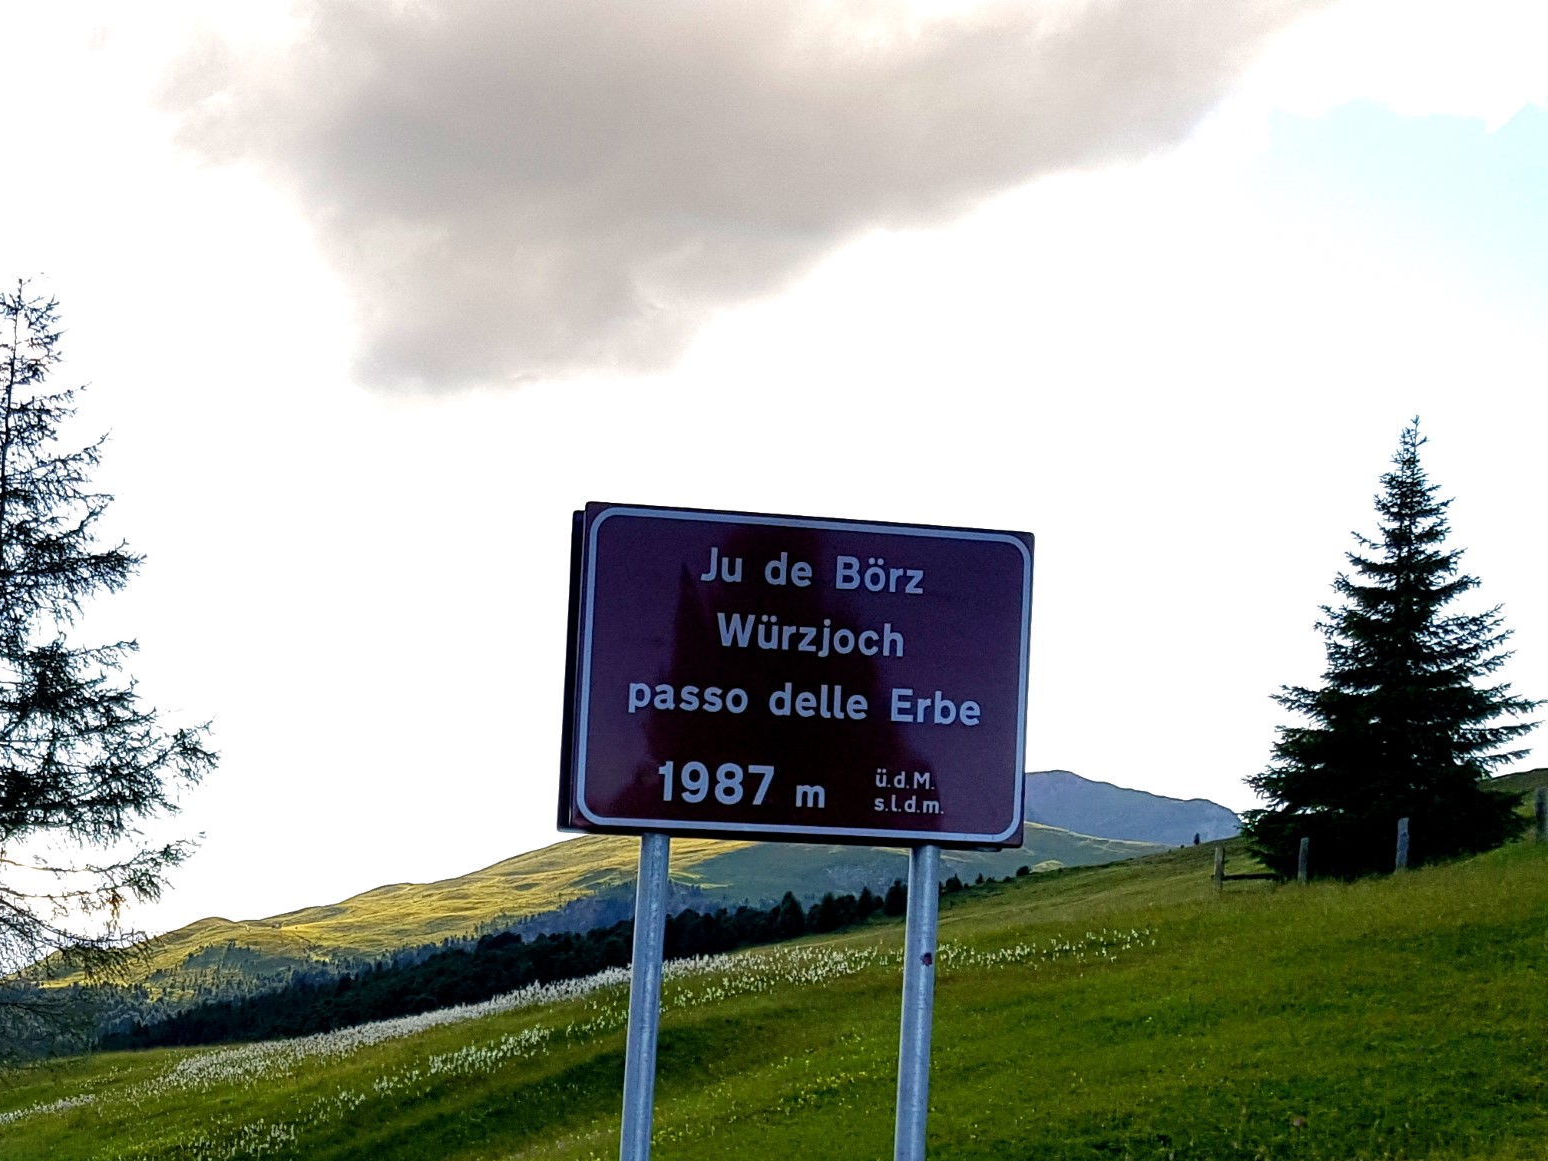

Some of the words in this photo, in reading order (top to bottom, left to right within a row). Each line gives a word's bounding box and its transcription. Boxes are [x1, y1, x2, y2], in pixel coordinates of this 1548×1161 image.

[700, 547, 743, 584] Ju
[765, 551, 812, 588] de
[835, 555, 924, 594] Börz
[717, 612, 904, 657] Würzjoch
[628, 682, 748, 715] passo
[769, 683, 868, 720] delle
[890, 688, 981, 726] Erbe
[657, 760, 775, 805] 1987
[795, 784, 825, 808] m
[874, 794, 944, 815] s.l.d.m.
